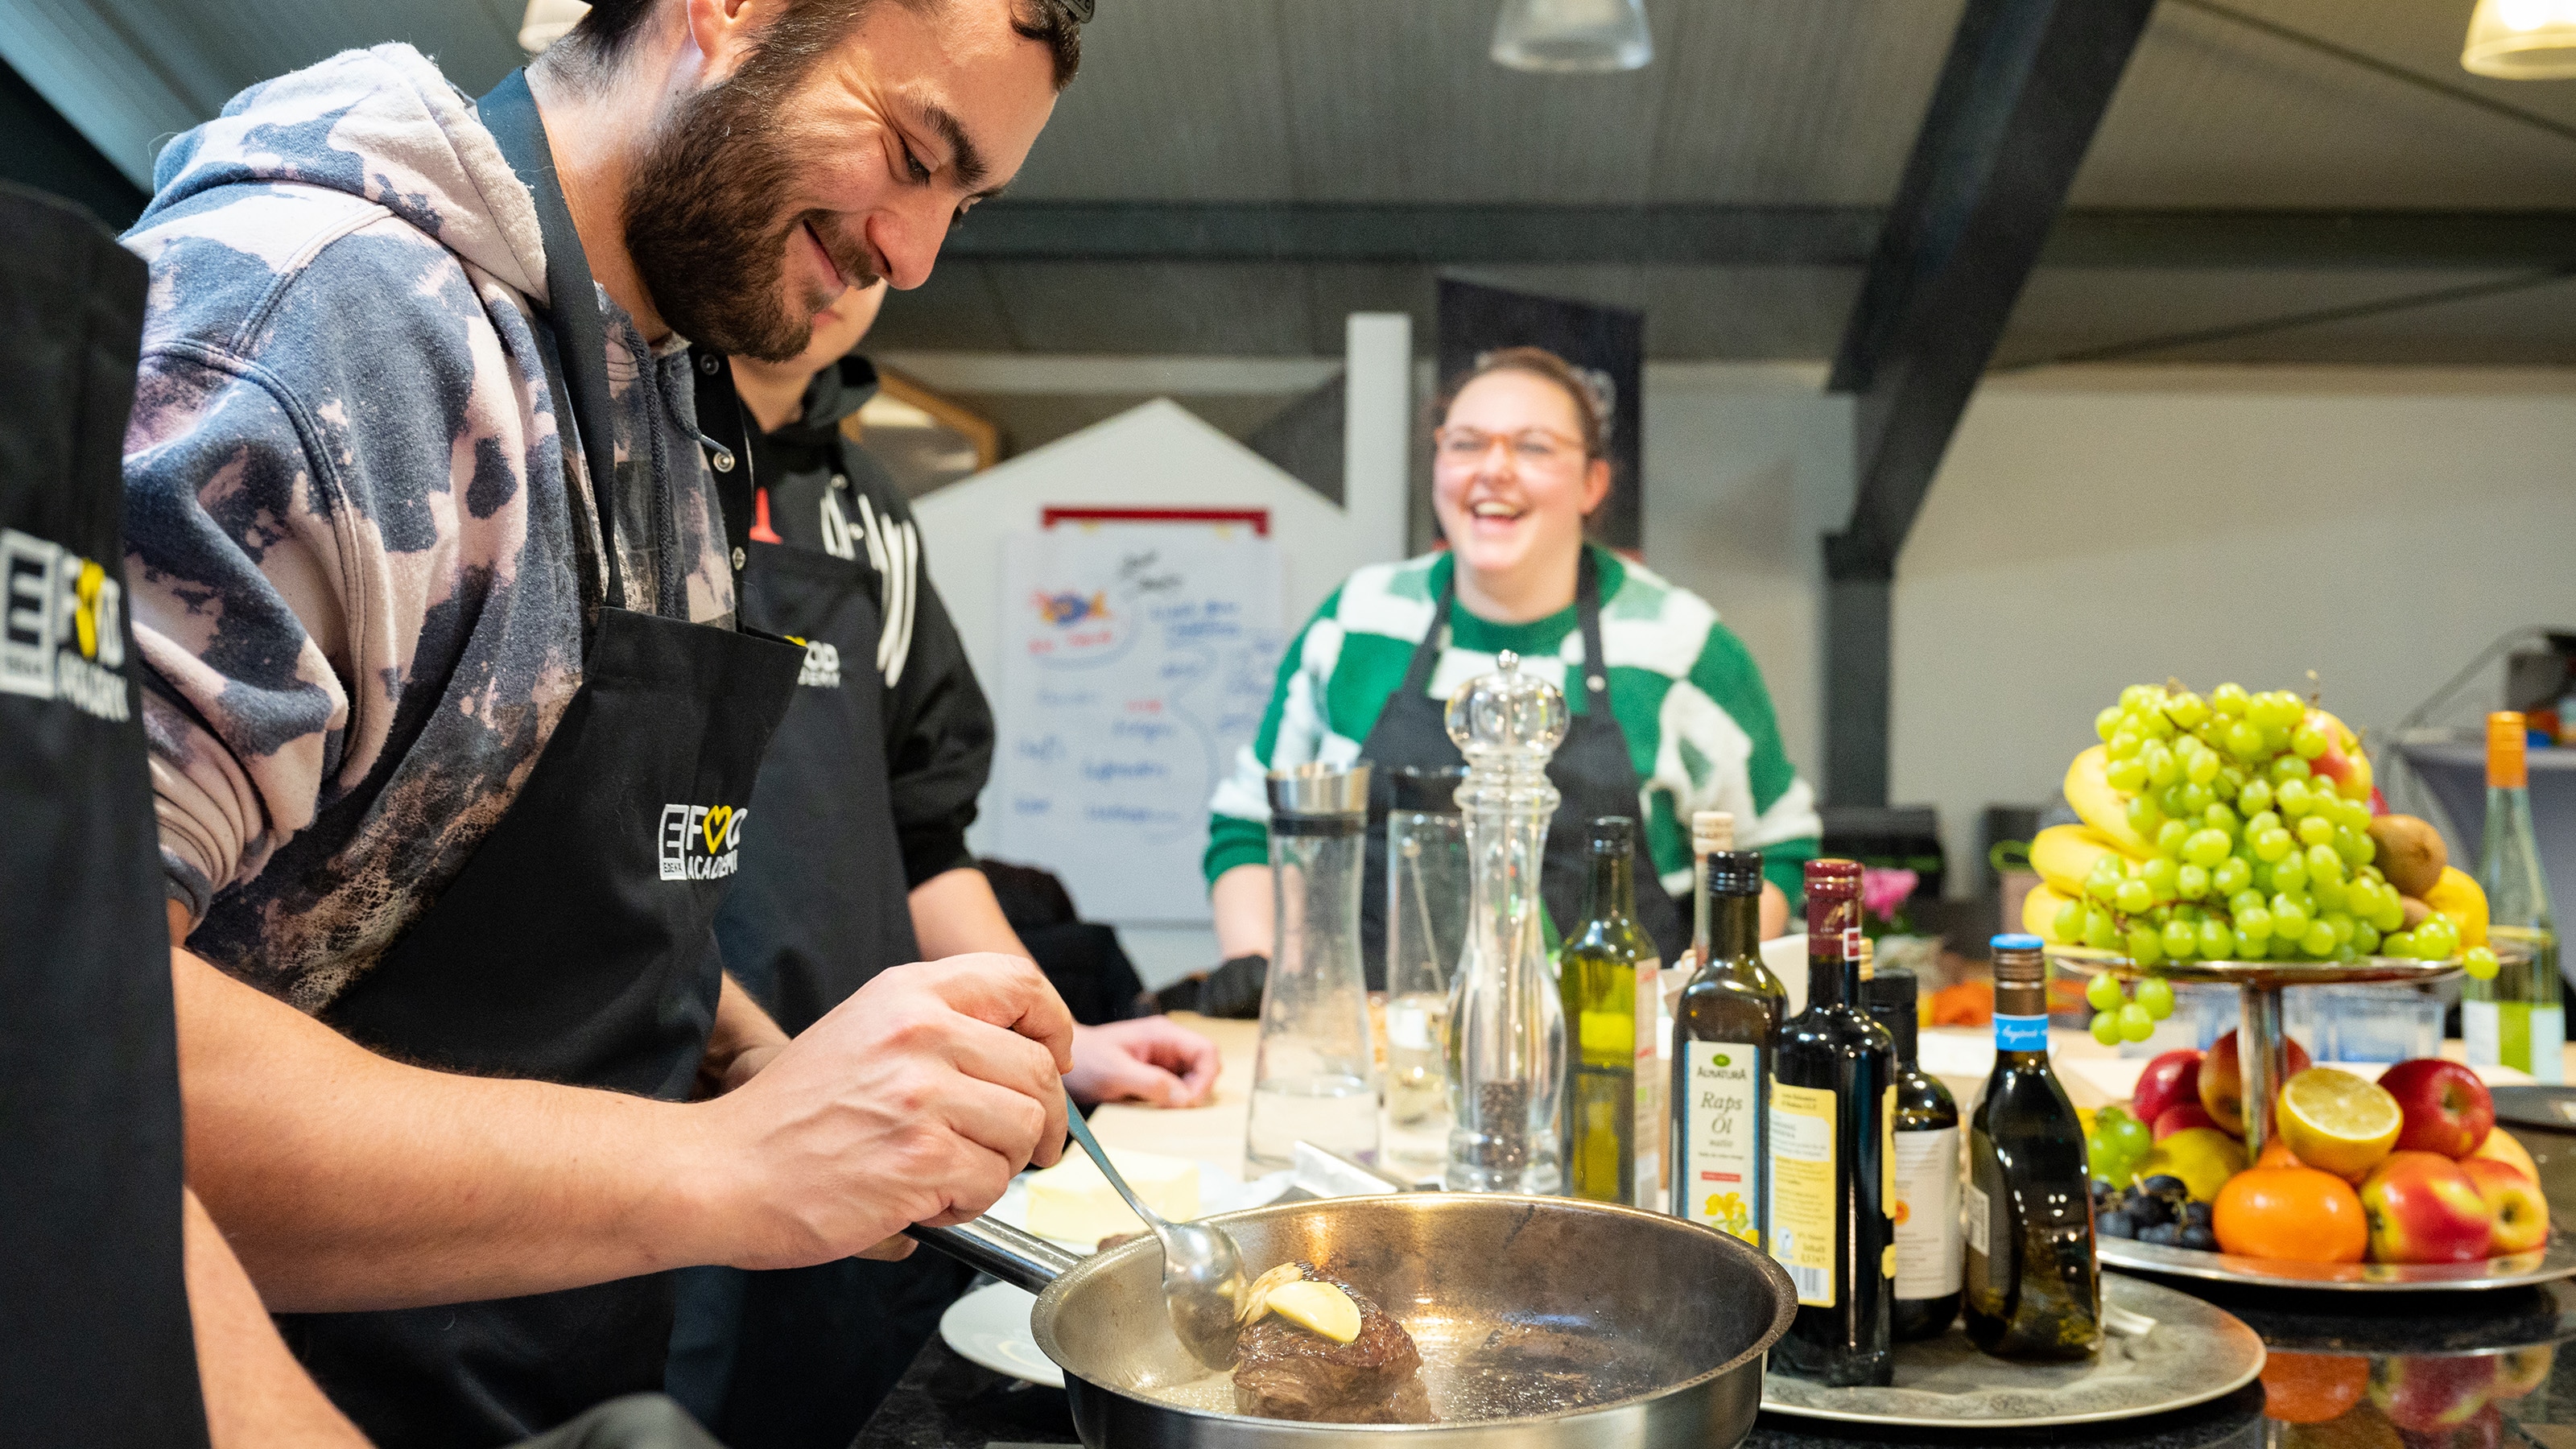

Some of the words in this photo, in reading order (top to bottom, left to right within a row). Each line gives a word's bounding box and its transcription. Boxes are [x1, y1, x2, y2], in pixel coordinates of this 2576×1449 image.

[687, 849, 738, 880] ACADEM
[1701, 1091, 1744, 1114] Raps
[1711, 1114, 1732, 1134] Öl
